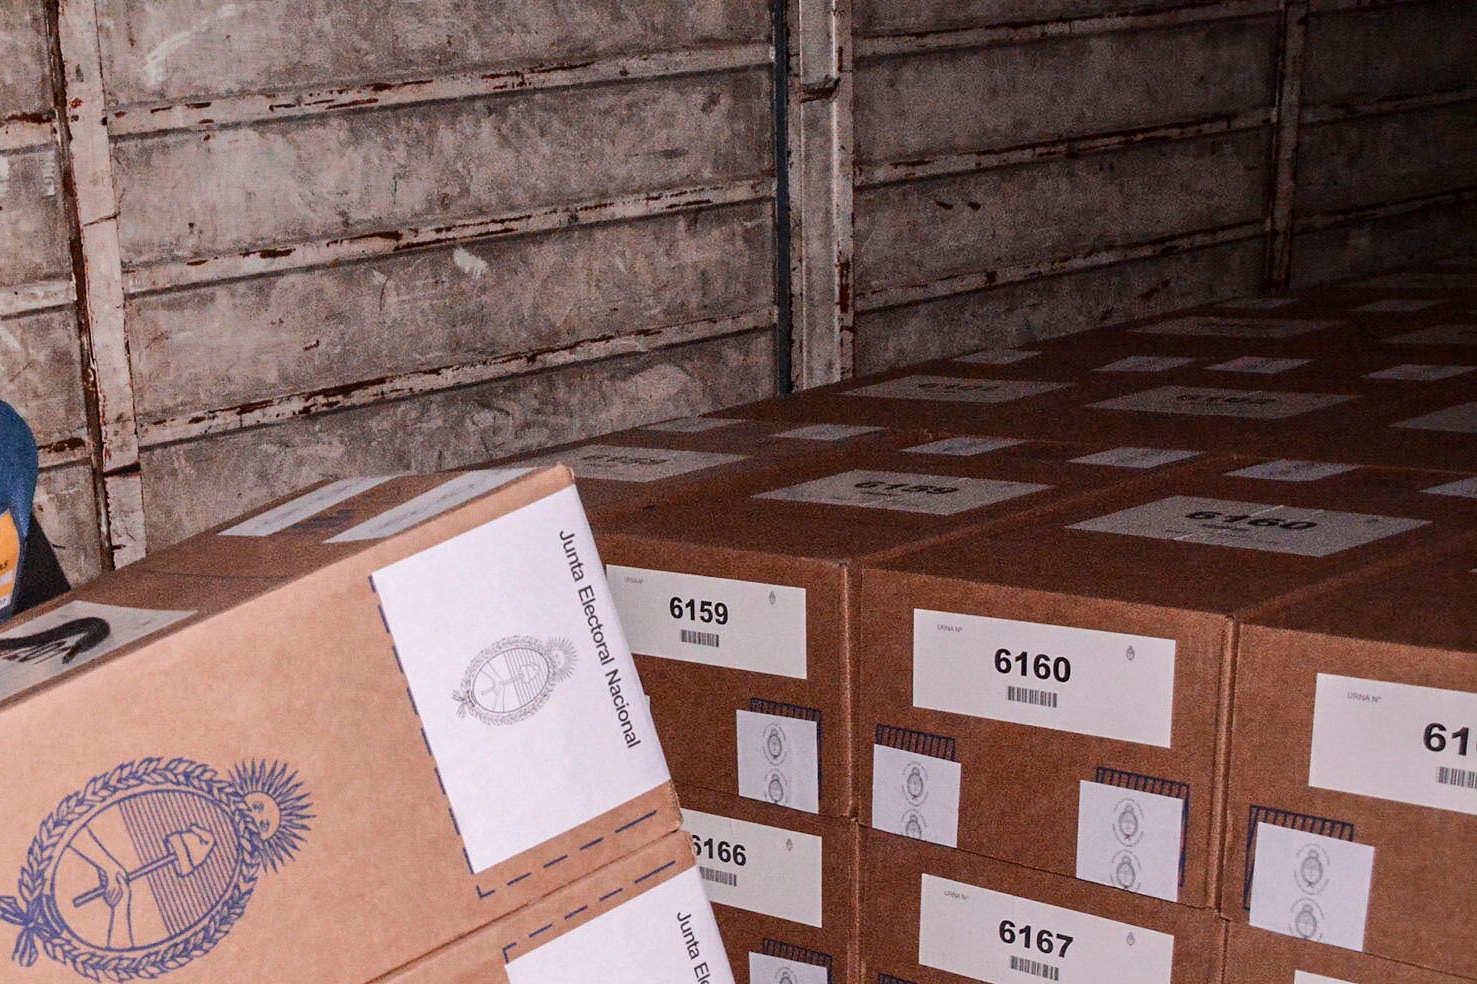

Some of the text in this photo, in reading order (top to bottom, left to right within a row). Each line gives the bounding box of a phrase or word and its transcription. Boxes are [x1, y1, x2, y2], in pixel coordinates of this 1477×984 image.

[1185, 510, 1318, 531] 6160
[669, 596, 729, 625] 6159
[559, 529, 642, 749] Junta Electoral Nacional
[993, 648, 1072, 683] 6160
[1423, 722, 1477, 757] 61
[691, 834, 747, 867] 6166
[676, 911, 700, 961] Junta
[998, 919, 1074, 958] 6167
